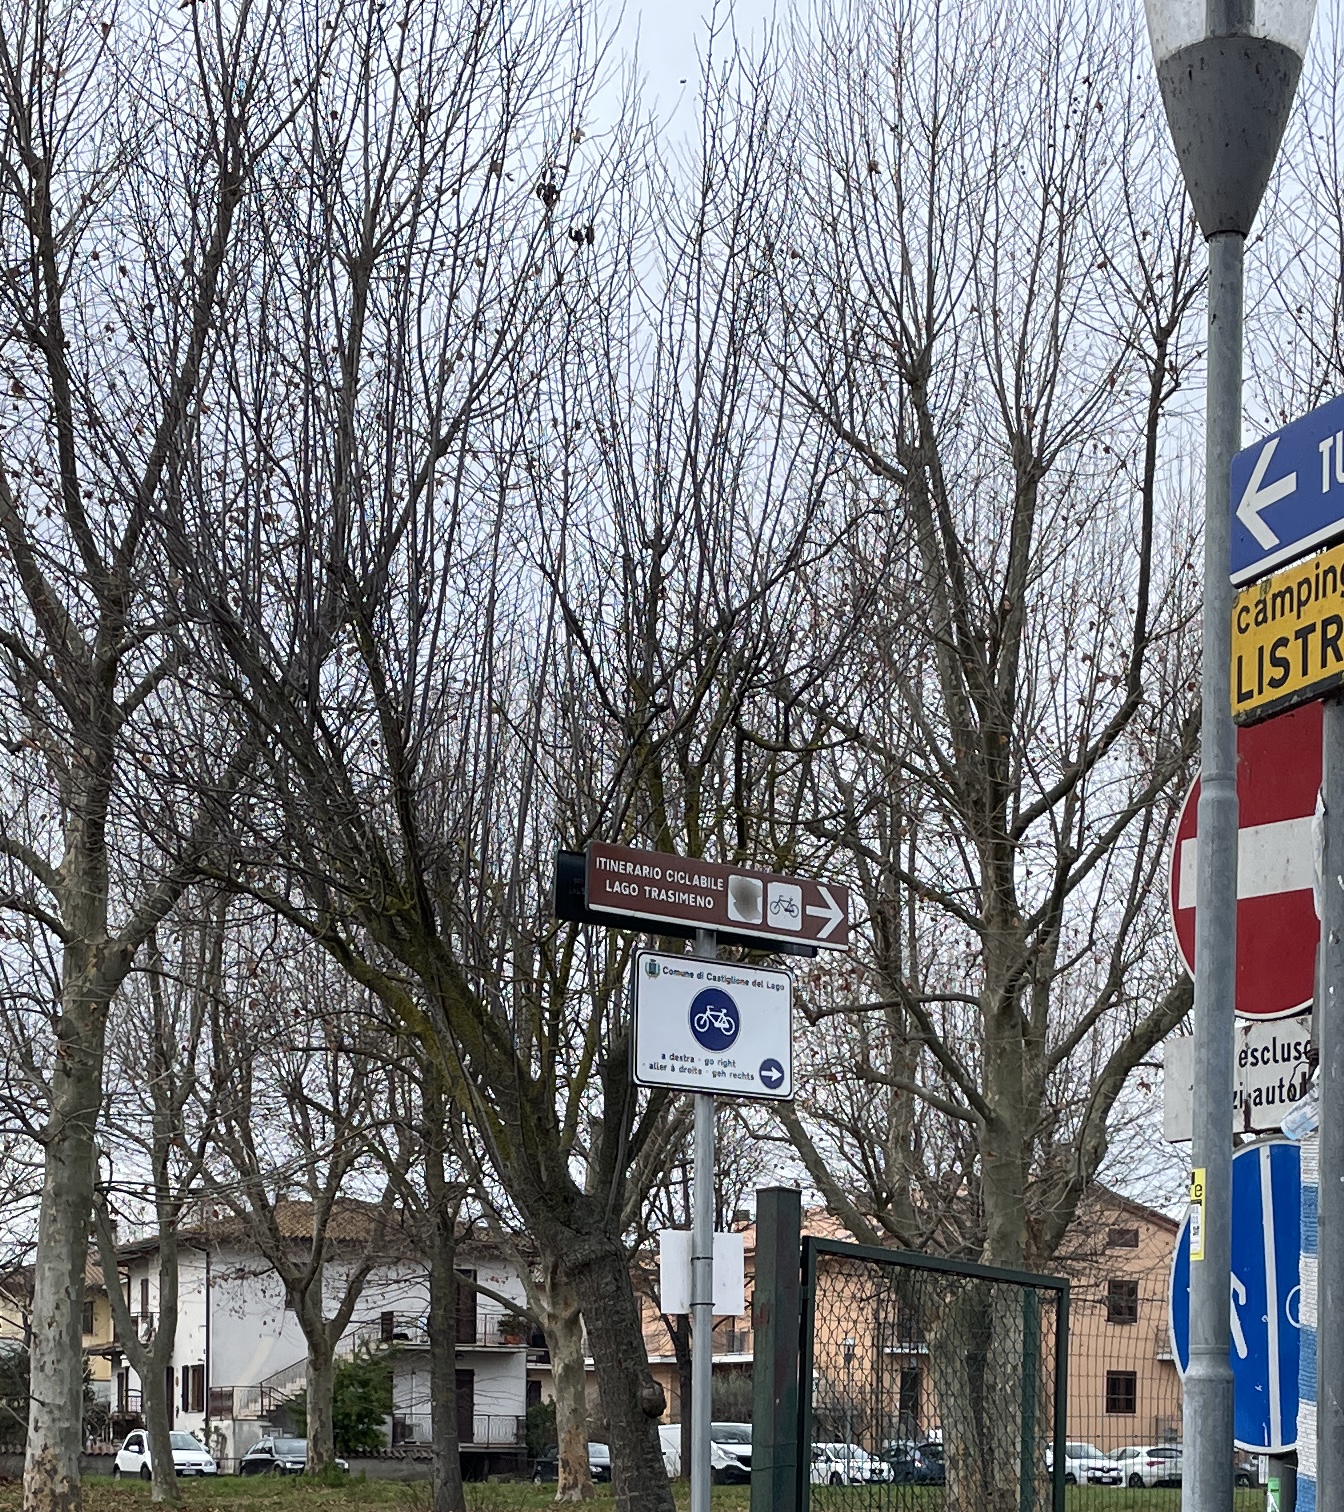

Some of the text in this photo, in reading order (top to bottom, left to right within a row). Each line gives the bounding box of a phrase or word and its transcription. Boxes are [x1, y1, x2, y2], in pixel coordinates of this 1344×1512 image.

[596, 857, 724, 891] ITINERARIO CICLABILE
[605, 880, 714, 909] LAGO TRASIMENO
[662, 966, 785, 992] Comune di Castiglione del Lago
[649, 1062, 668, 1072] aller
[678, 1064, 703, 1076] droite
[712, 1069, 727, 1079] geh
[729, 1071, 755, 1082] rechts
[669, 1052, 695, 1063] destra
[704, 1058, 715, 1067] go
[717, 1058, 737, 1069] right
